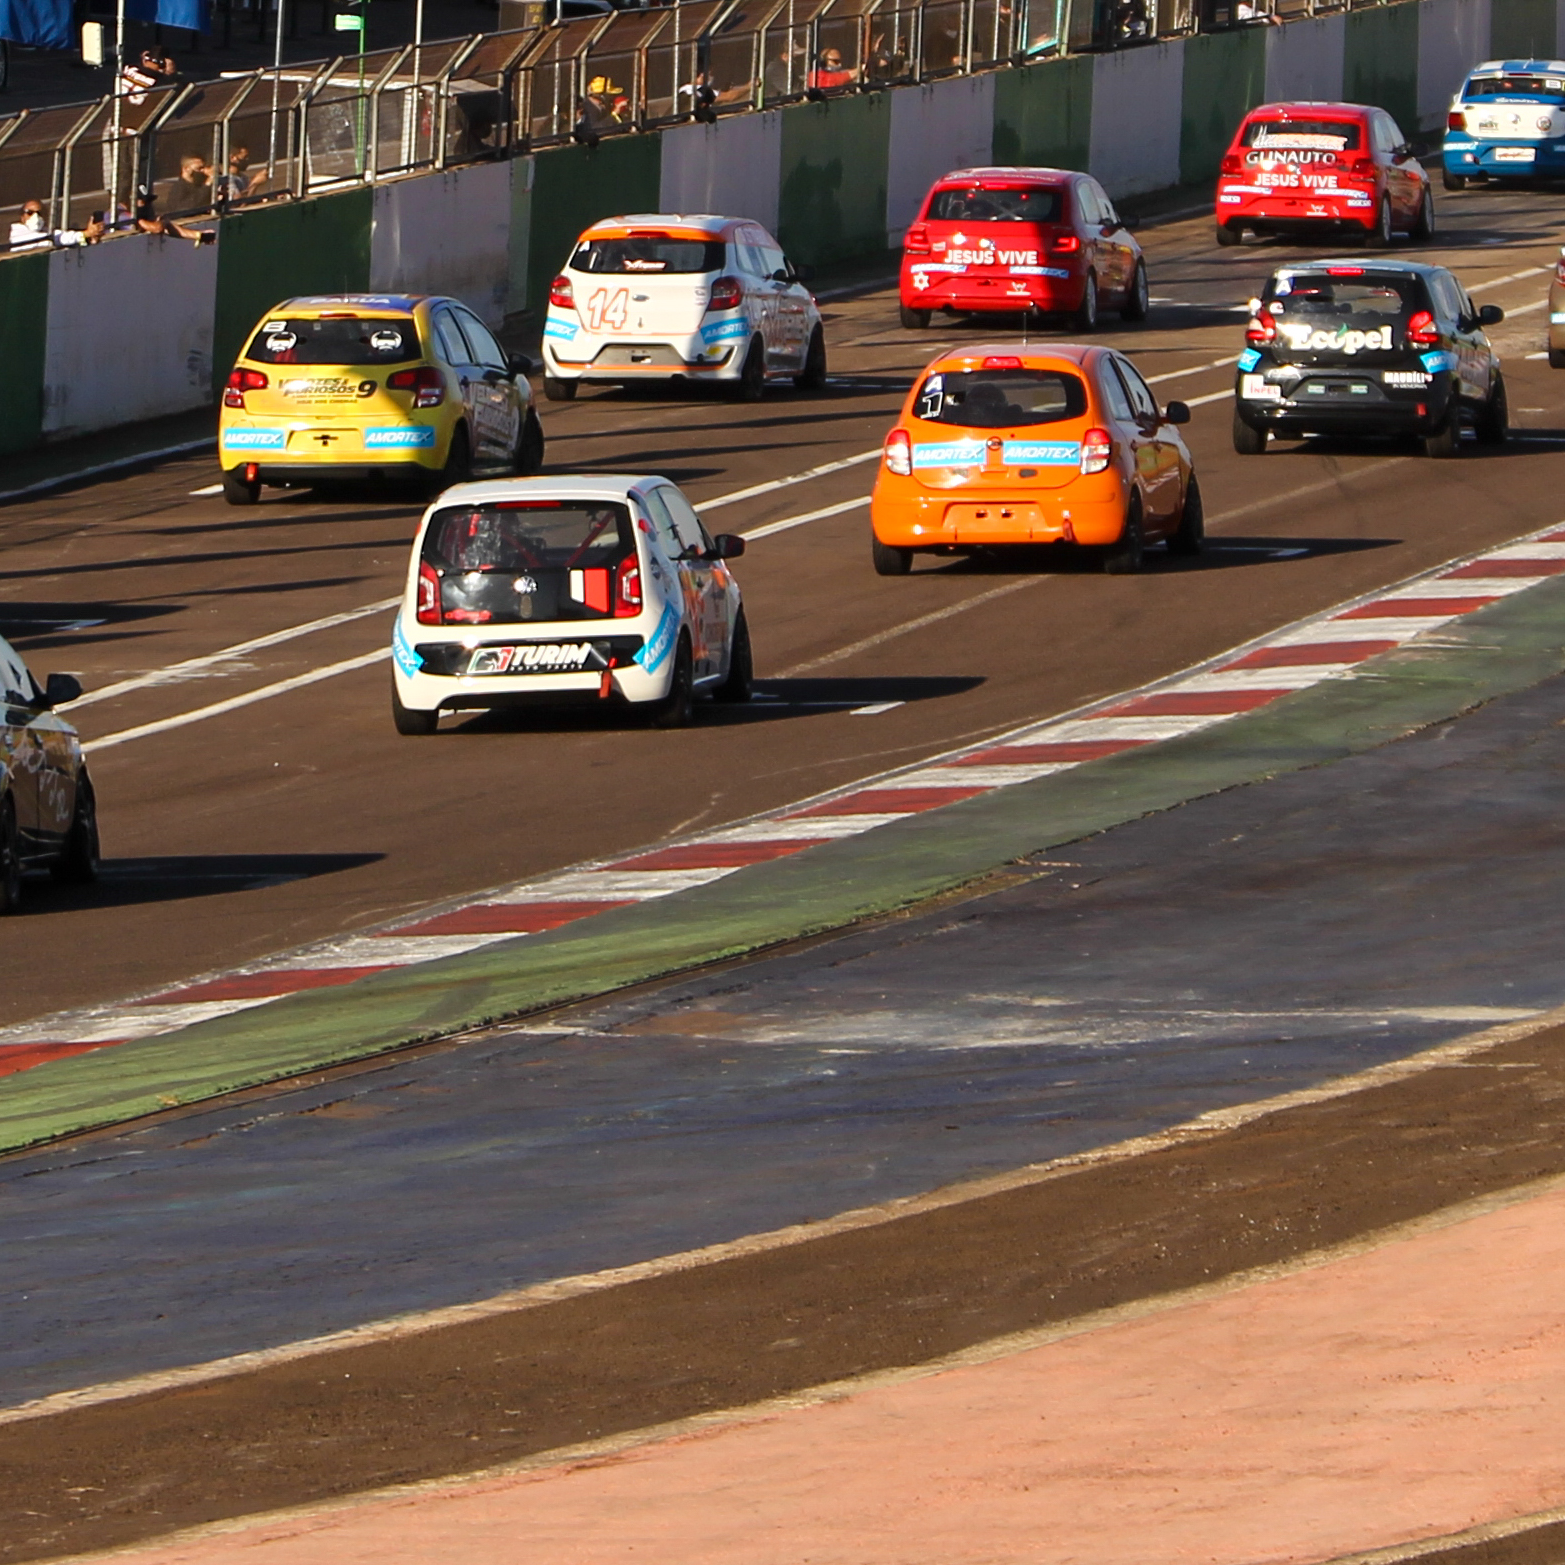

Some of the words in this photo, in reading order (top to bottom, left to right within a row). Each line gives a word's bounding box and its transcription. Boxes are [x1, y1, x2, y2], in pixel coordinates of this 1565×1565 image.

[1254, 173, 1300, 187] JESUS
[1302, 175, 1338, 188] VIVE
[944, 250, 995, 265] JESUS
[997, 250, 1039, 265] VIVE
[588, 288, 629, 330] 14
[262, 321, 288, 333] B
[1284, 322, 1394, 355] Ecopel
[355, 380, 378, 399] 9
[223, 433, 282, 445] AMORTEX
[364, 429, 432, 444] AMORTEX
[915, 447, 984, 462] AMORTEX
[1004, 446, 1076, 459] AMORTEX
[509, 642, 594, 668] TURIM
